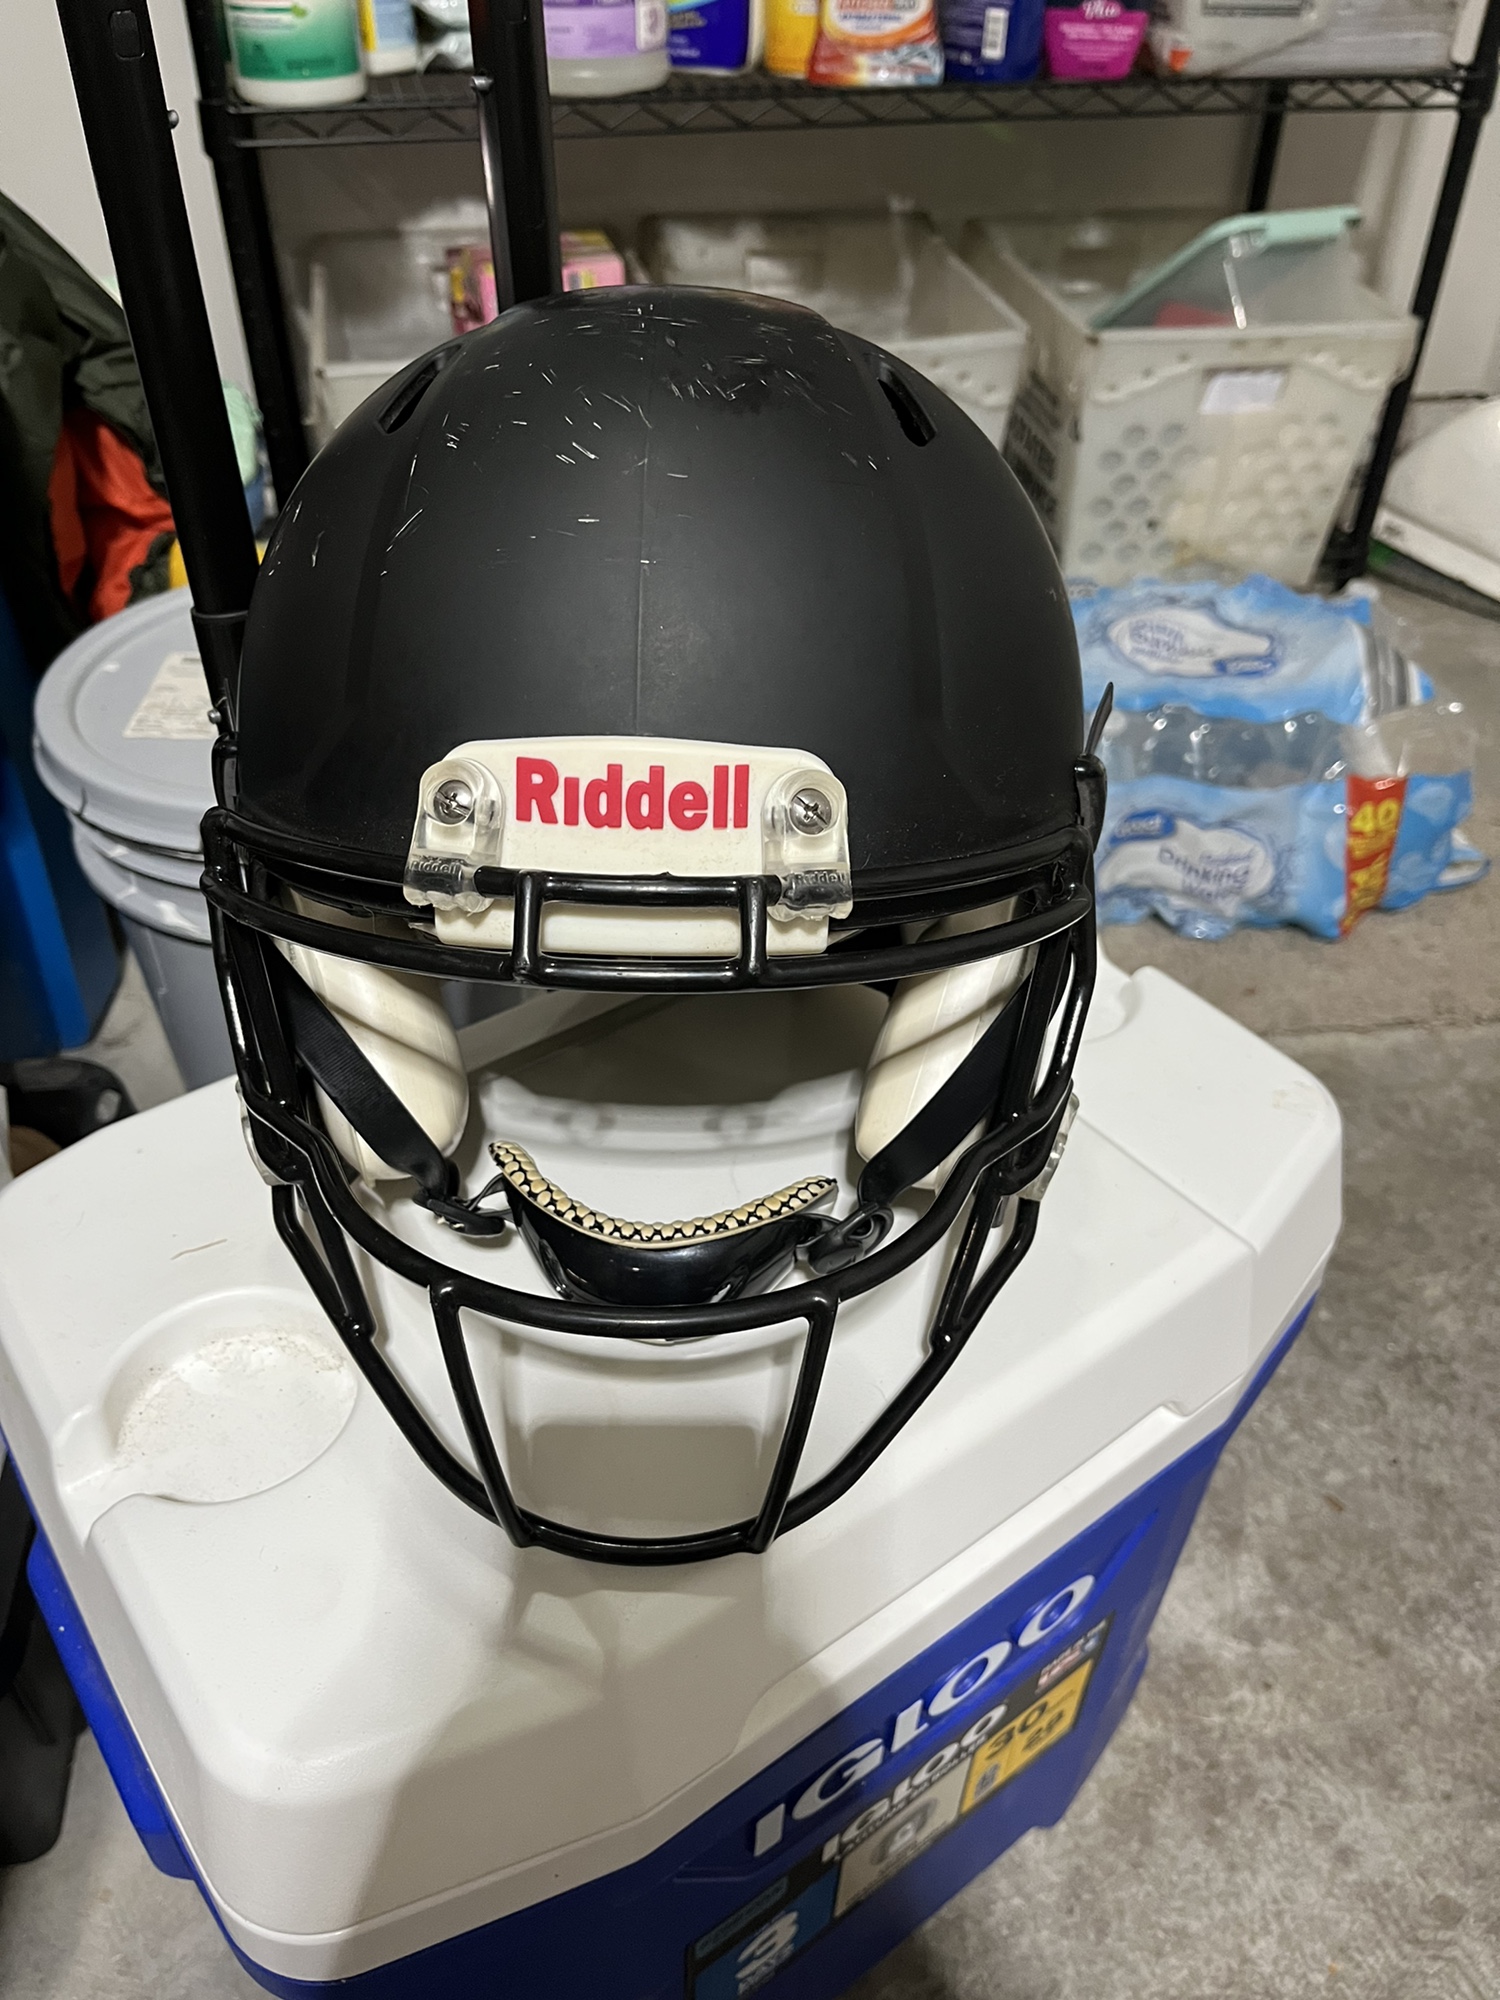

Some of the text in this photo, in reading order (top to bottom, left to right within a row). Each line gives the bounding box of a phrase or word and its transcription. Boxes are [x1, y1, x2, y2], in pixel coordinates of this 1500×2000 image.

[516, 756, 750, 831] Riddell
[1350, 797, 1400, 837] 40
[754, 1574, 1096, 1858] IGLOO
[821, 1704, 1008, 1863] IGLOO
[734, 1911, 799, 1980] 3
